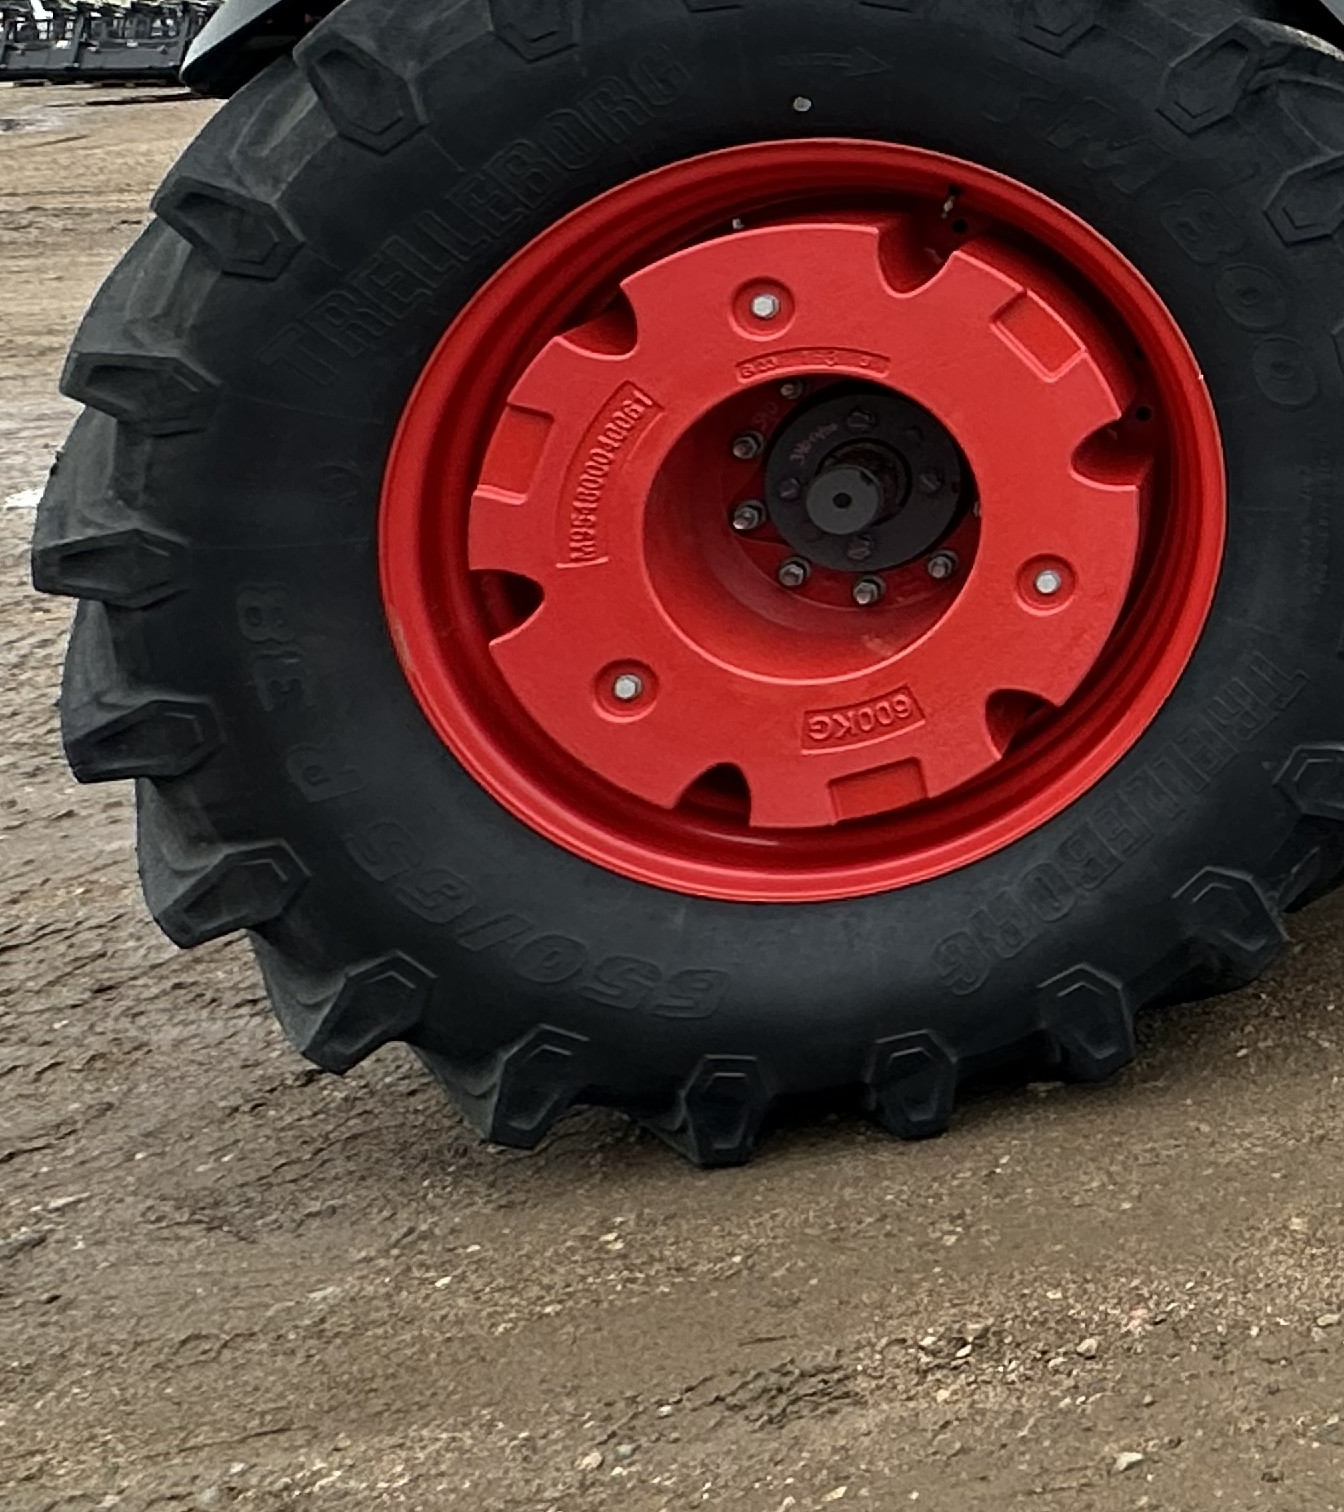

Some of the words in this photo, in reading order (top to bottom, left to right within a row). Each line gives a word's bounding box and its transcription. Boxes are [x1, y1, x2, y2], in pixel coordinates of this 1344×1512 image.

[257, 44, 693, 389] TRELLEBORG
[1159, 187, 1321, 409] 800
[286, 735, 363, 802] R
[808, 694, 911, 740] 600KG
[930, 651, 1308, 996] TRELLEBORG
[342, 816, 731, 1020] 650/65
